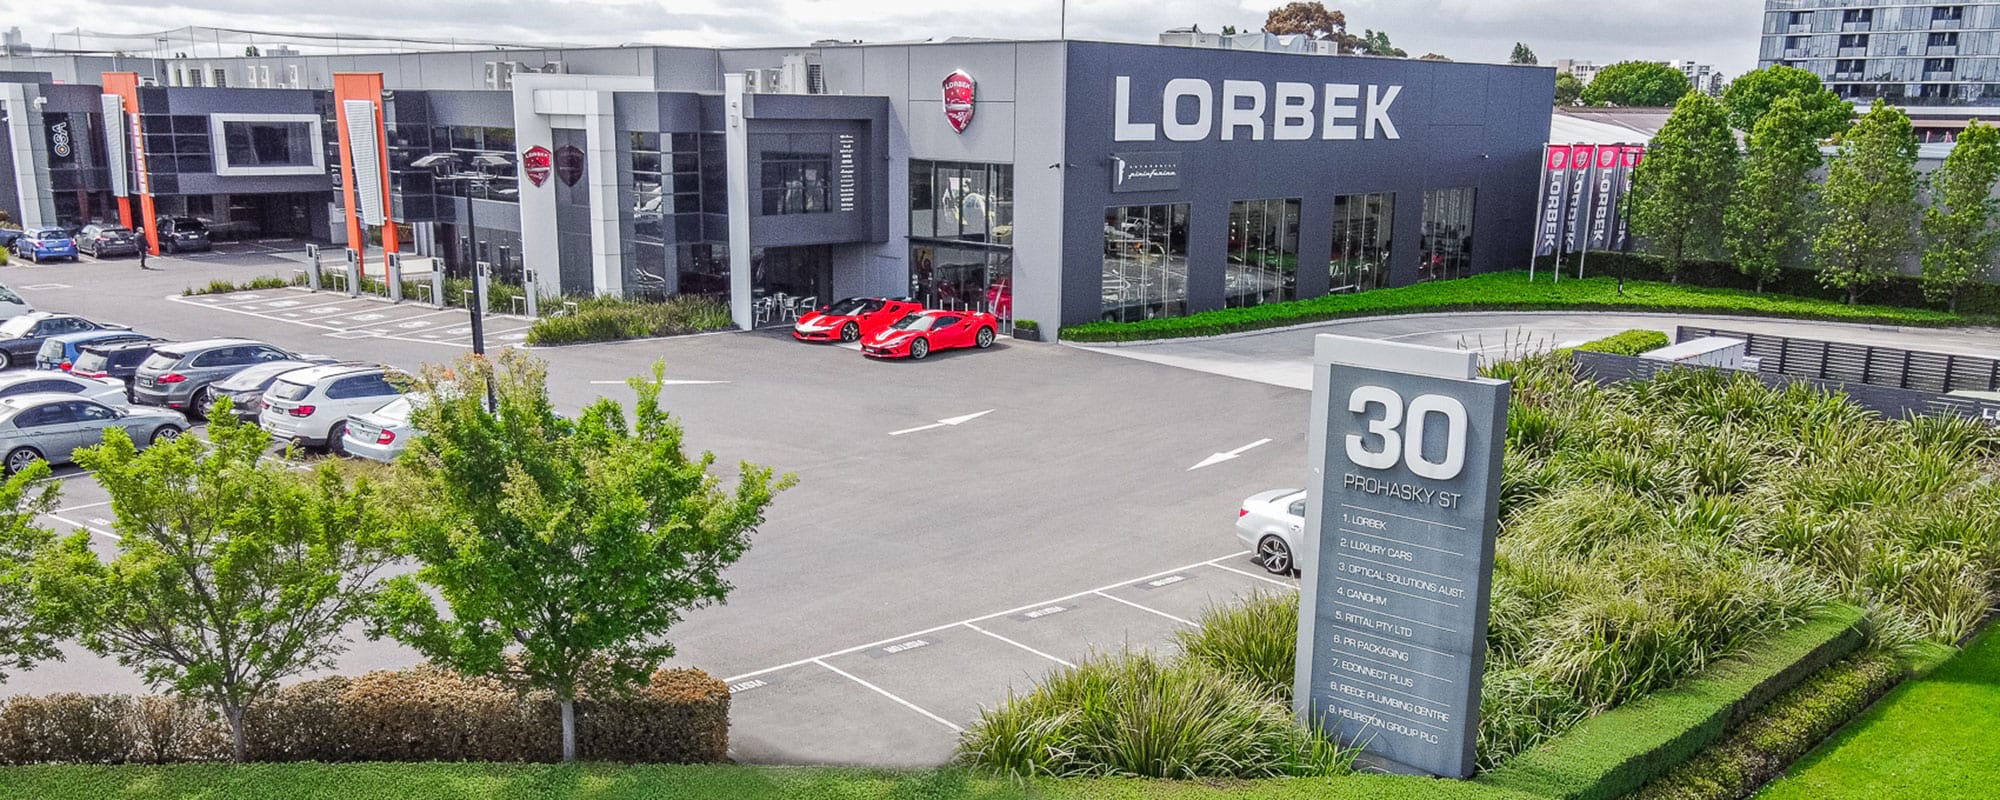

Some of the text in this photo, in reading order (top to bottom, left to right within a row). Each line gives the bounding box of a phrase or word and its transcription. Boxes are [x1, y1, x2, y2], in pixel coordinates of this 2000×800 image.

[1115, 76, 1402, 141] LORBEK
[1545, 171, 1564, 247] LORBEK
[1594, 169, 1612, 241] LORBEK
[1345, 385, 1468, 481] 30
[1344, 473, 1462, 510] PROHASKY ST
[1352, 514, 1387, 530] LORBEK
[1350, 540, 1386, 555] LUXURY
[1388, 548, 1413, 562] CARS
[1346, 590, 1387, 606] CANOHM
[1348, 564, 1385, 580] OPTICAL
[1386, 573, 1437, 593] SOLUTIONS
[1439, 585, 1466, 599] AUST.
[1345, 613, 1374, 628] RITTAL
[1376, 620, 1394, 633] PTY
[1394, 625, 1413, 638] LTD
[1344, 636, 1356, 648] PR
[1357, 640, 1409, 662] PACKAGING
[1342, 660, 1388, 680] ECONNECT
[1389, 674, 1414, 688] PLUS
[1340, 684, 1366, 699] REECE
[1367, 691, 1413, 713] PLUMBING
[1414, 705, 1450, 723] CENTRE
[1338, 707, 1386, 729] HEURSTON
[1386, 722, 1419, 737] GROUP
[1420, 731, 1439, 744] PLC
